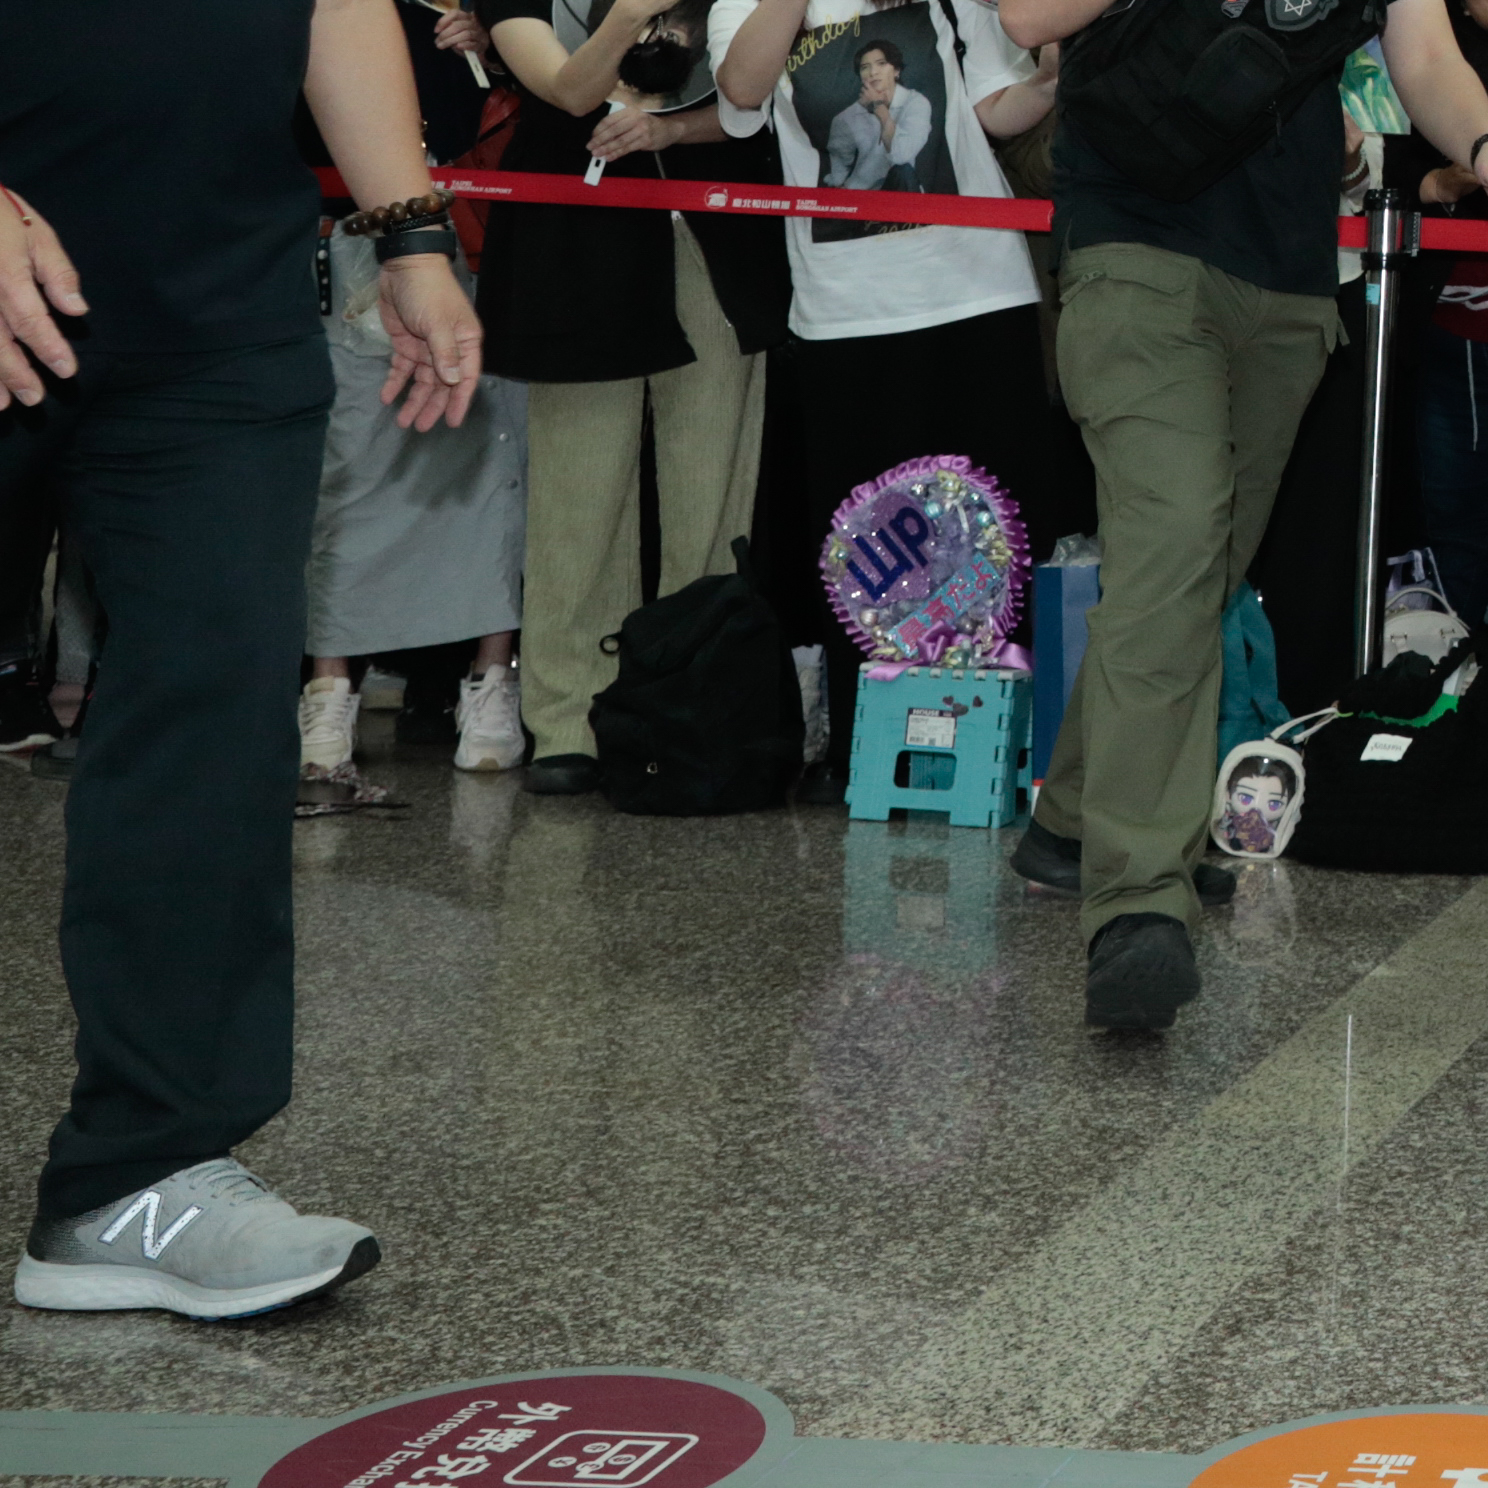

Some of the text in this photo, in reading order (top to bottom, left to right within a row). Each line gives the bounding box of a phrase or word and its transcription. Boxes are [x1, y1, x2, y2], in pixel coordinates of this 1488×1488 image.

[395, 1401, 573, 1488] 外幣兌
[402, 1400, 499, 1449] Currency
[1335, 1452, 1415, 1488] 計
